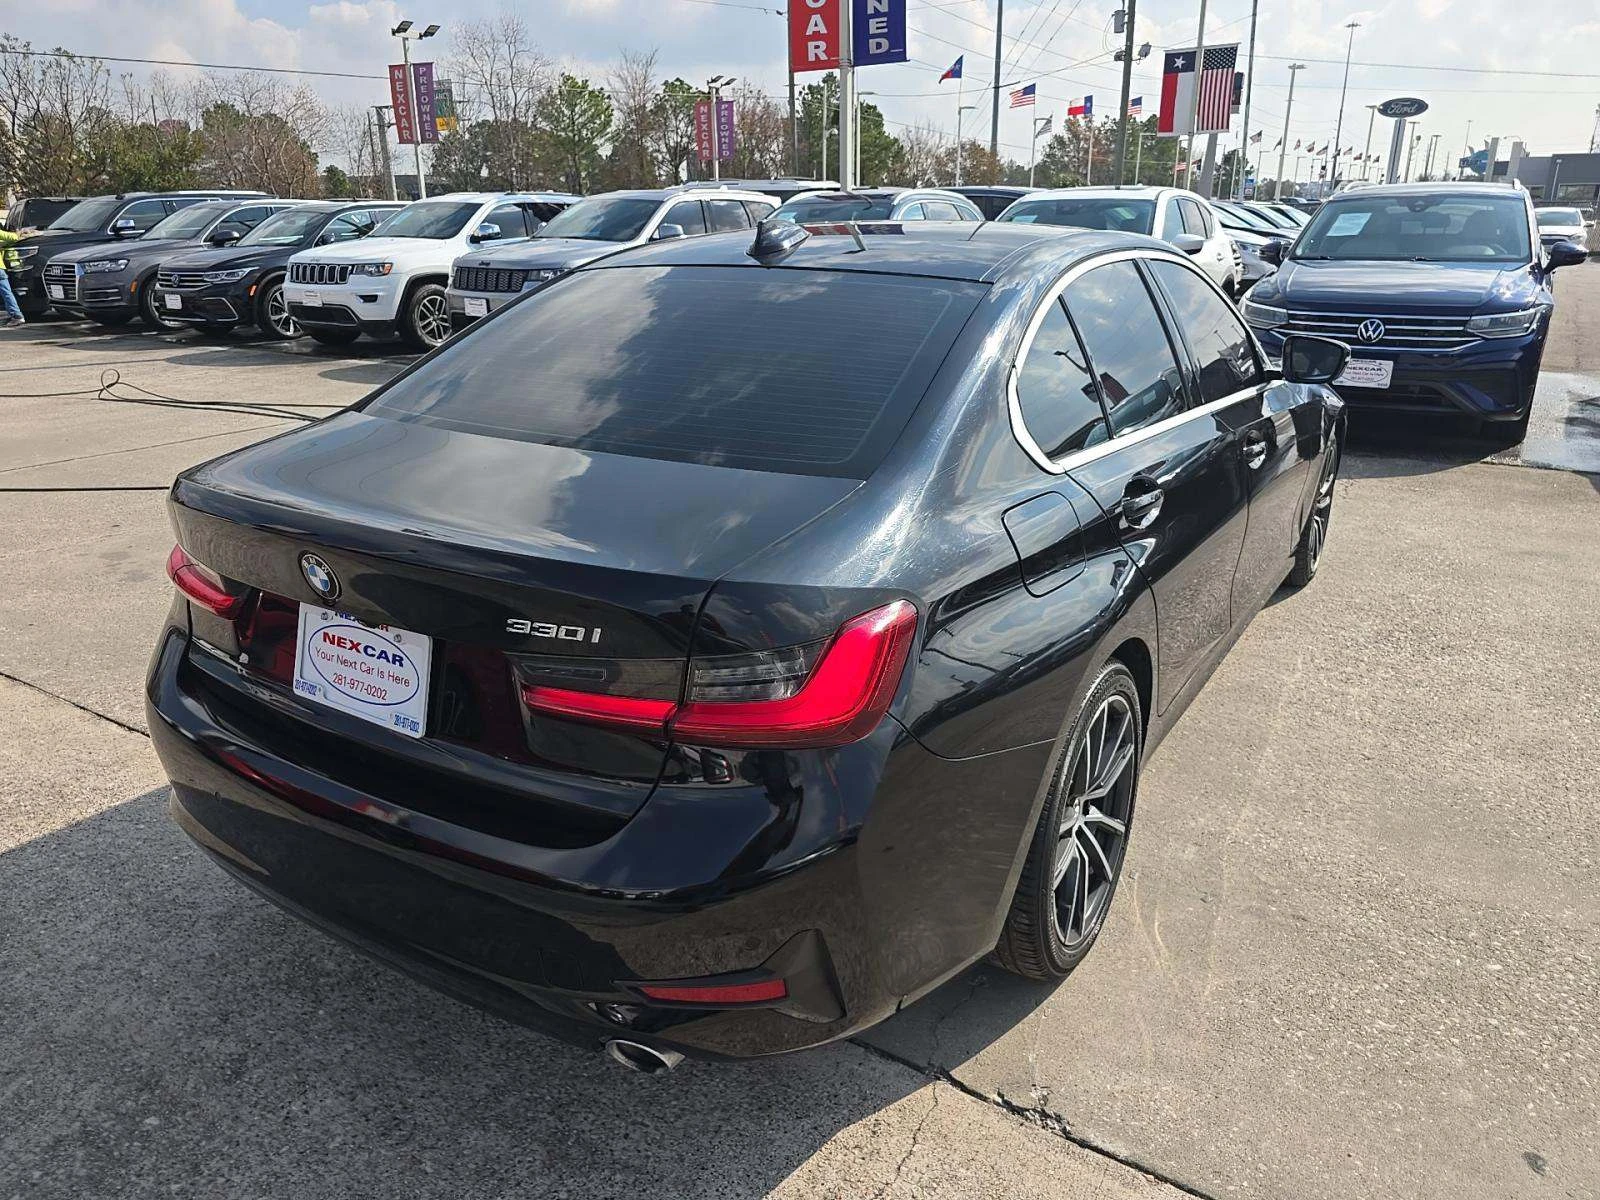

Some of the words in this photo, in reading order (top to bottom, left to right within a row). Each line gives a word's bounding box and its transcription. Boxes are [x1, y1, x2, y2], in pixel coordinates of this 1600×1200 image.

[395, 69, 411, 139] NEXCAR
[419, 67, 433, 139] PREOWNED
[1387, 101, 1418, 114] Ford
[700, 105, 710, 157] NEXCAR
[720, 104, 730, 156] PREOWNED
[315, 646, 335, 662] Your
[336, 654, 357, 671] Next
[360, 661, 375, 675] Car
[377, 666, 385, 678] Is
[387, 670, 410, 688] Here
[323, 631, 404, 667] NEXCAR
[332, 672, 388, 701] 281-977-0202
